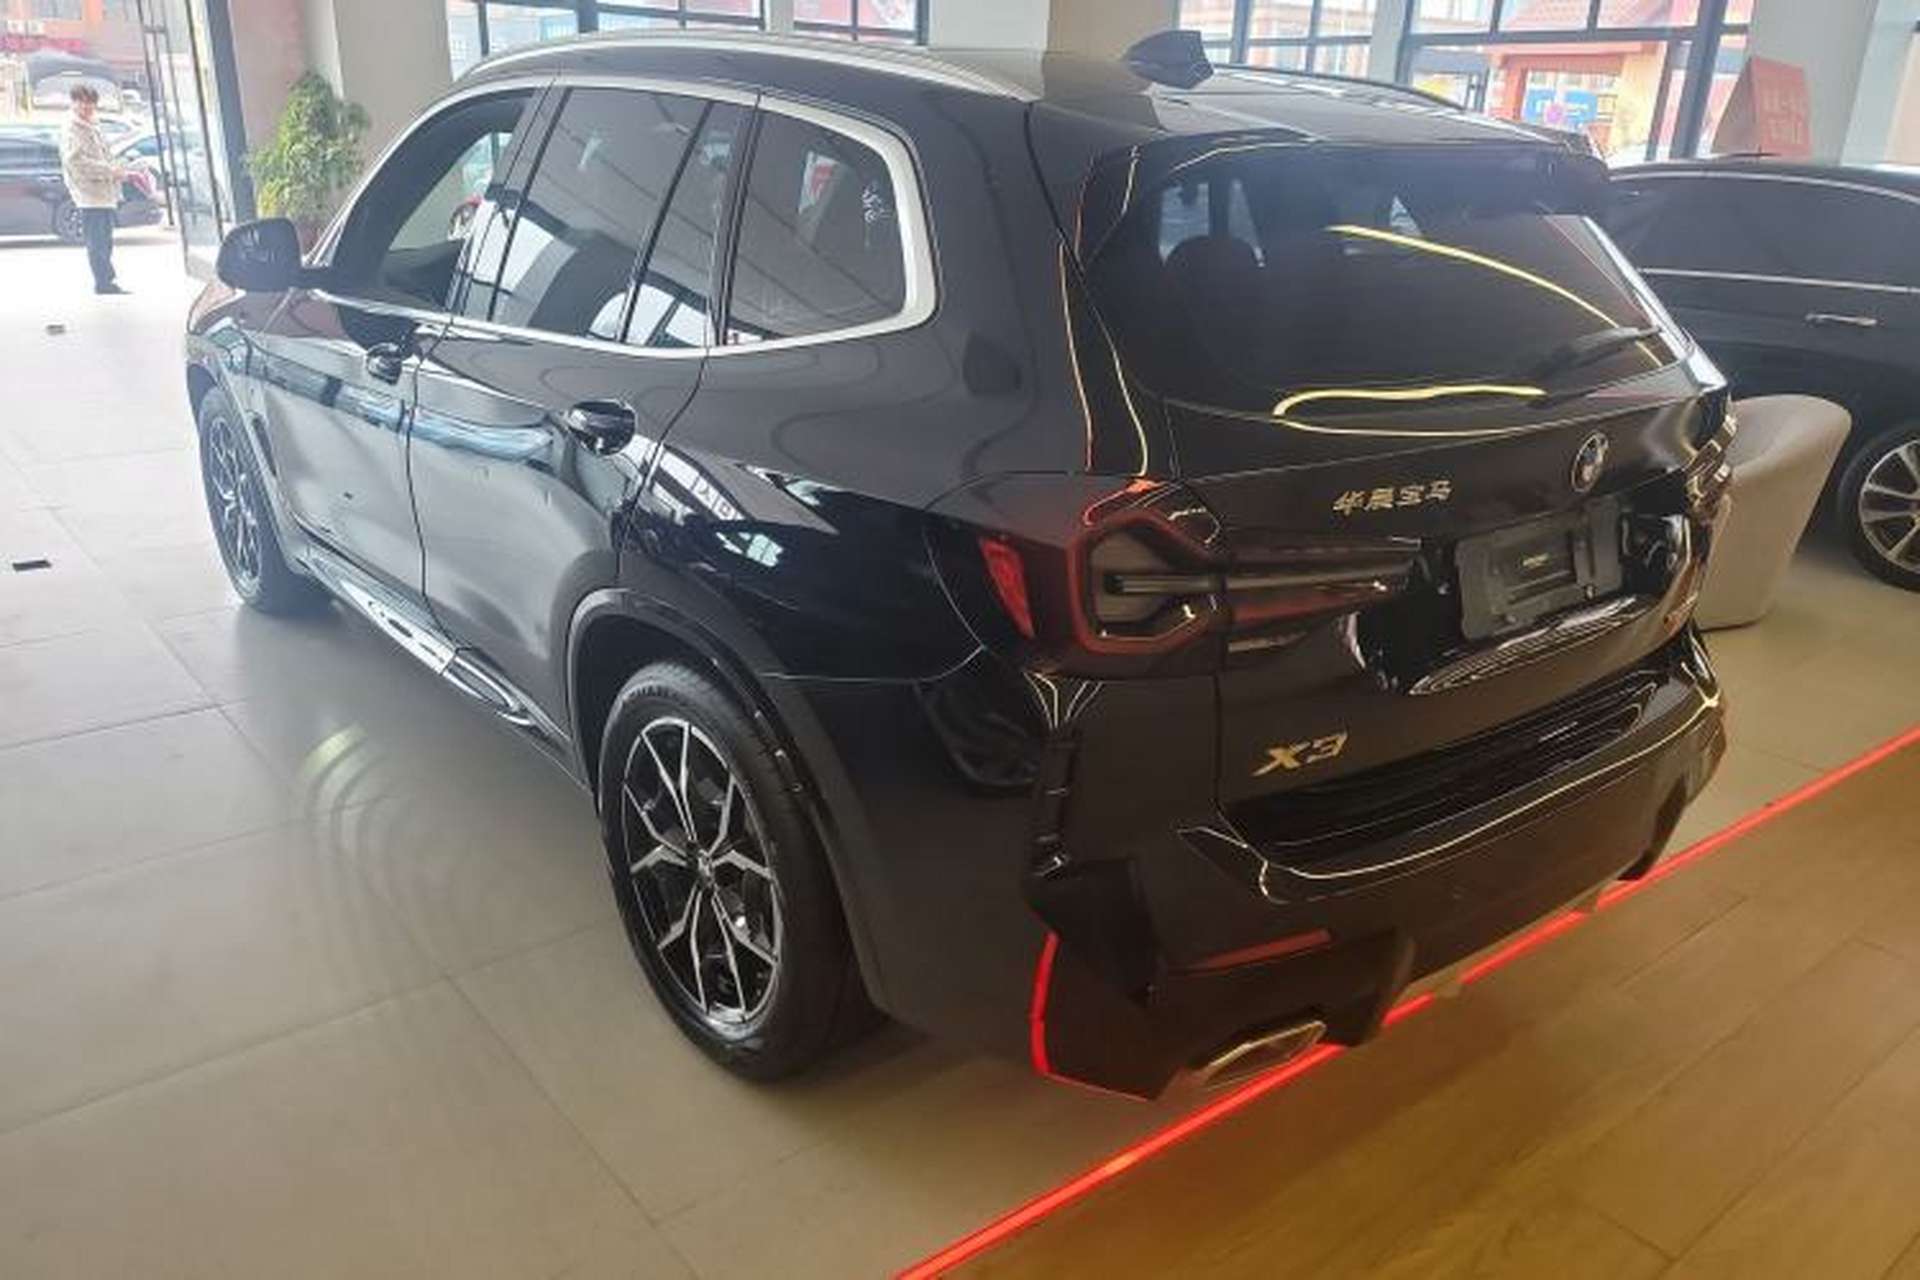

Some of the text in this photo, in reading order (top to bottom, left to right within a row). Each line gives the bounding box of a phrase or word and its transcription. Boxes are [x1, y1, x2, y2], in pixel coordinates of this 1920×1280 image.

[1332, 480, 1452, 515] 华晨宝马
[1252, 731, 1348, 776] X3
